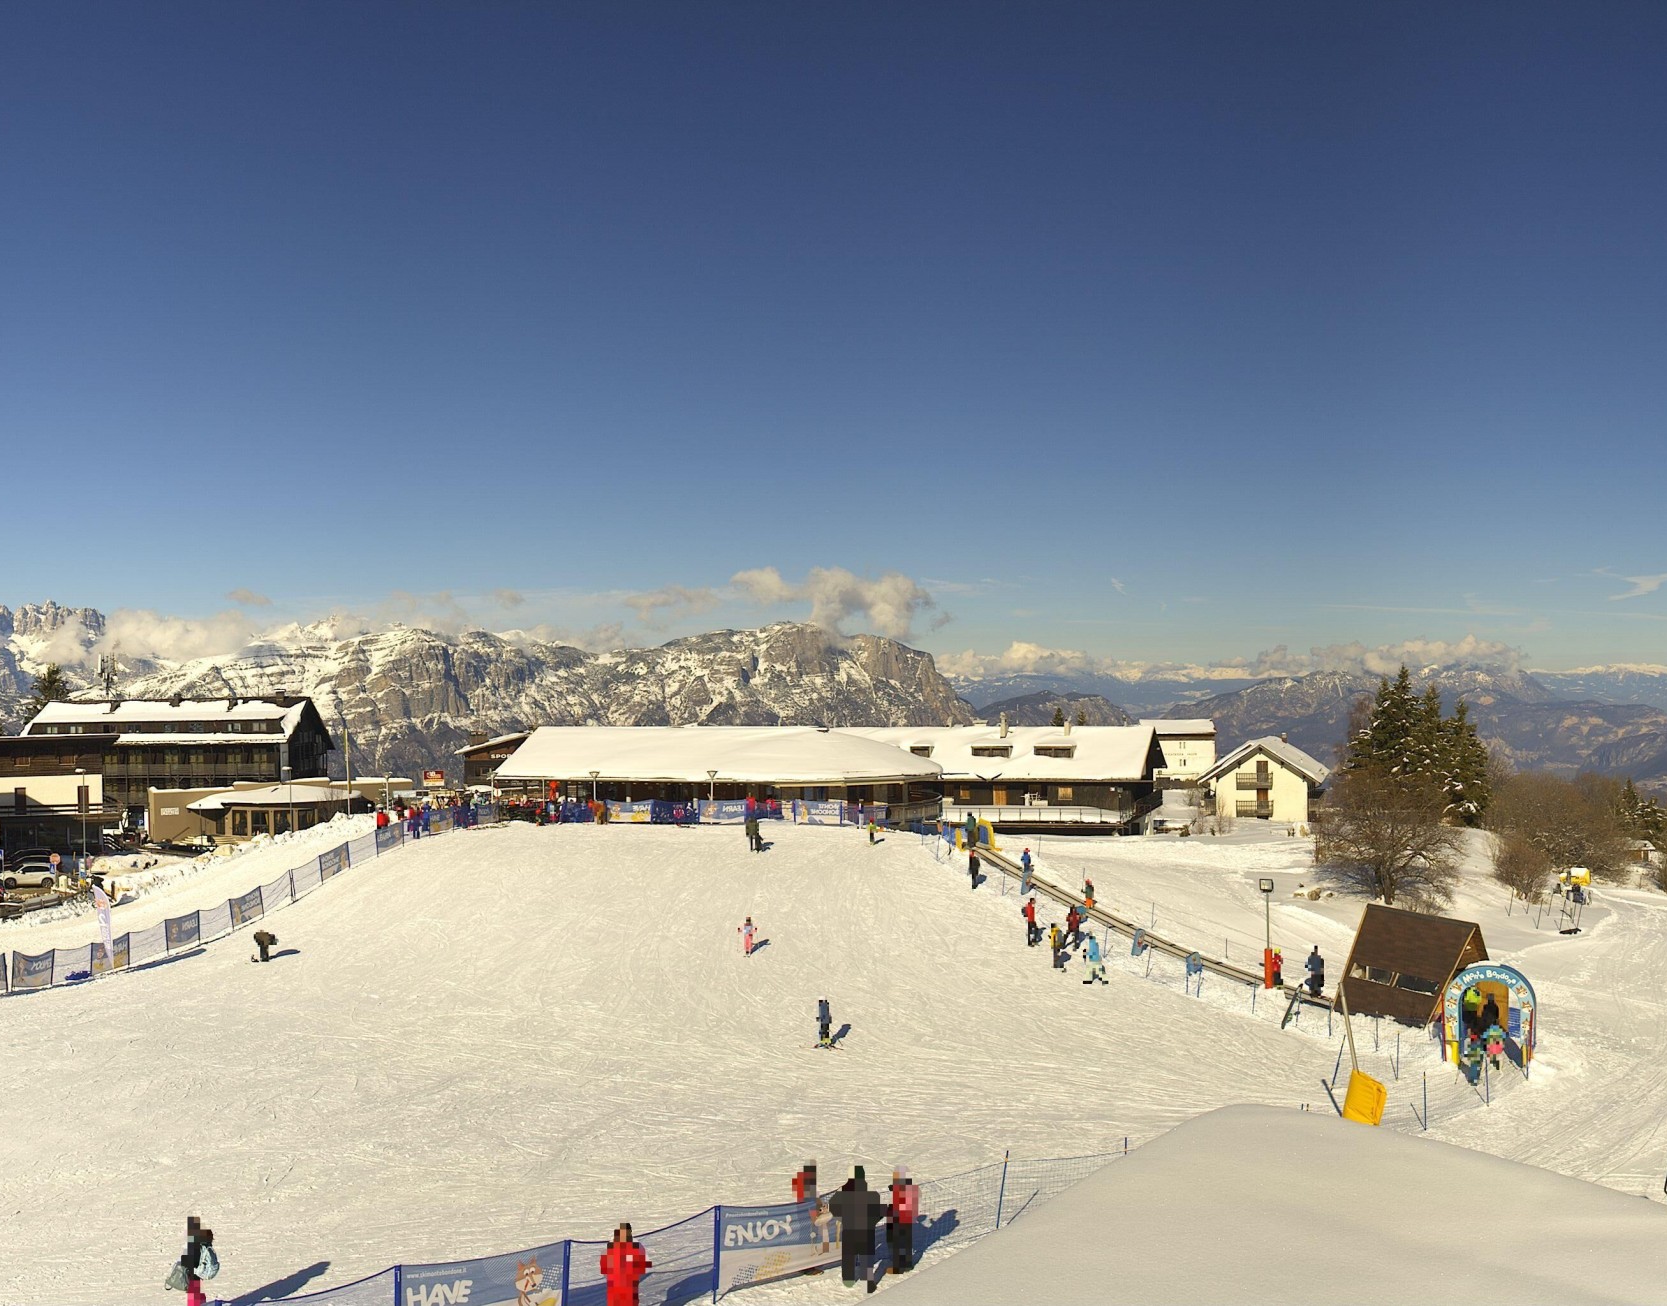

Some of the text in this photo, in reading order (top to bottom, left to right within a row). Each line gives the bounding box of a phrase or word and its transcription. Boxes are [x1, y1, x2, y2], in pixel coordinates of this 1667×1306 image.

[1462, 969, 1517, 984] Monte Bondone
[723, 1214, 793, 1247] ENJOY
[406, 1279, 474, 1306] HAVE
